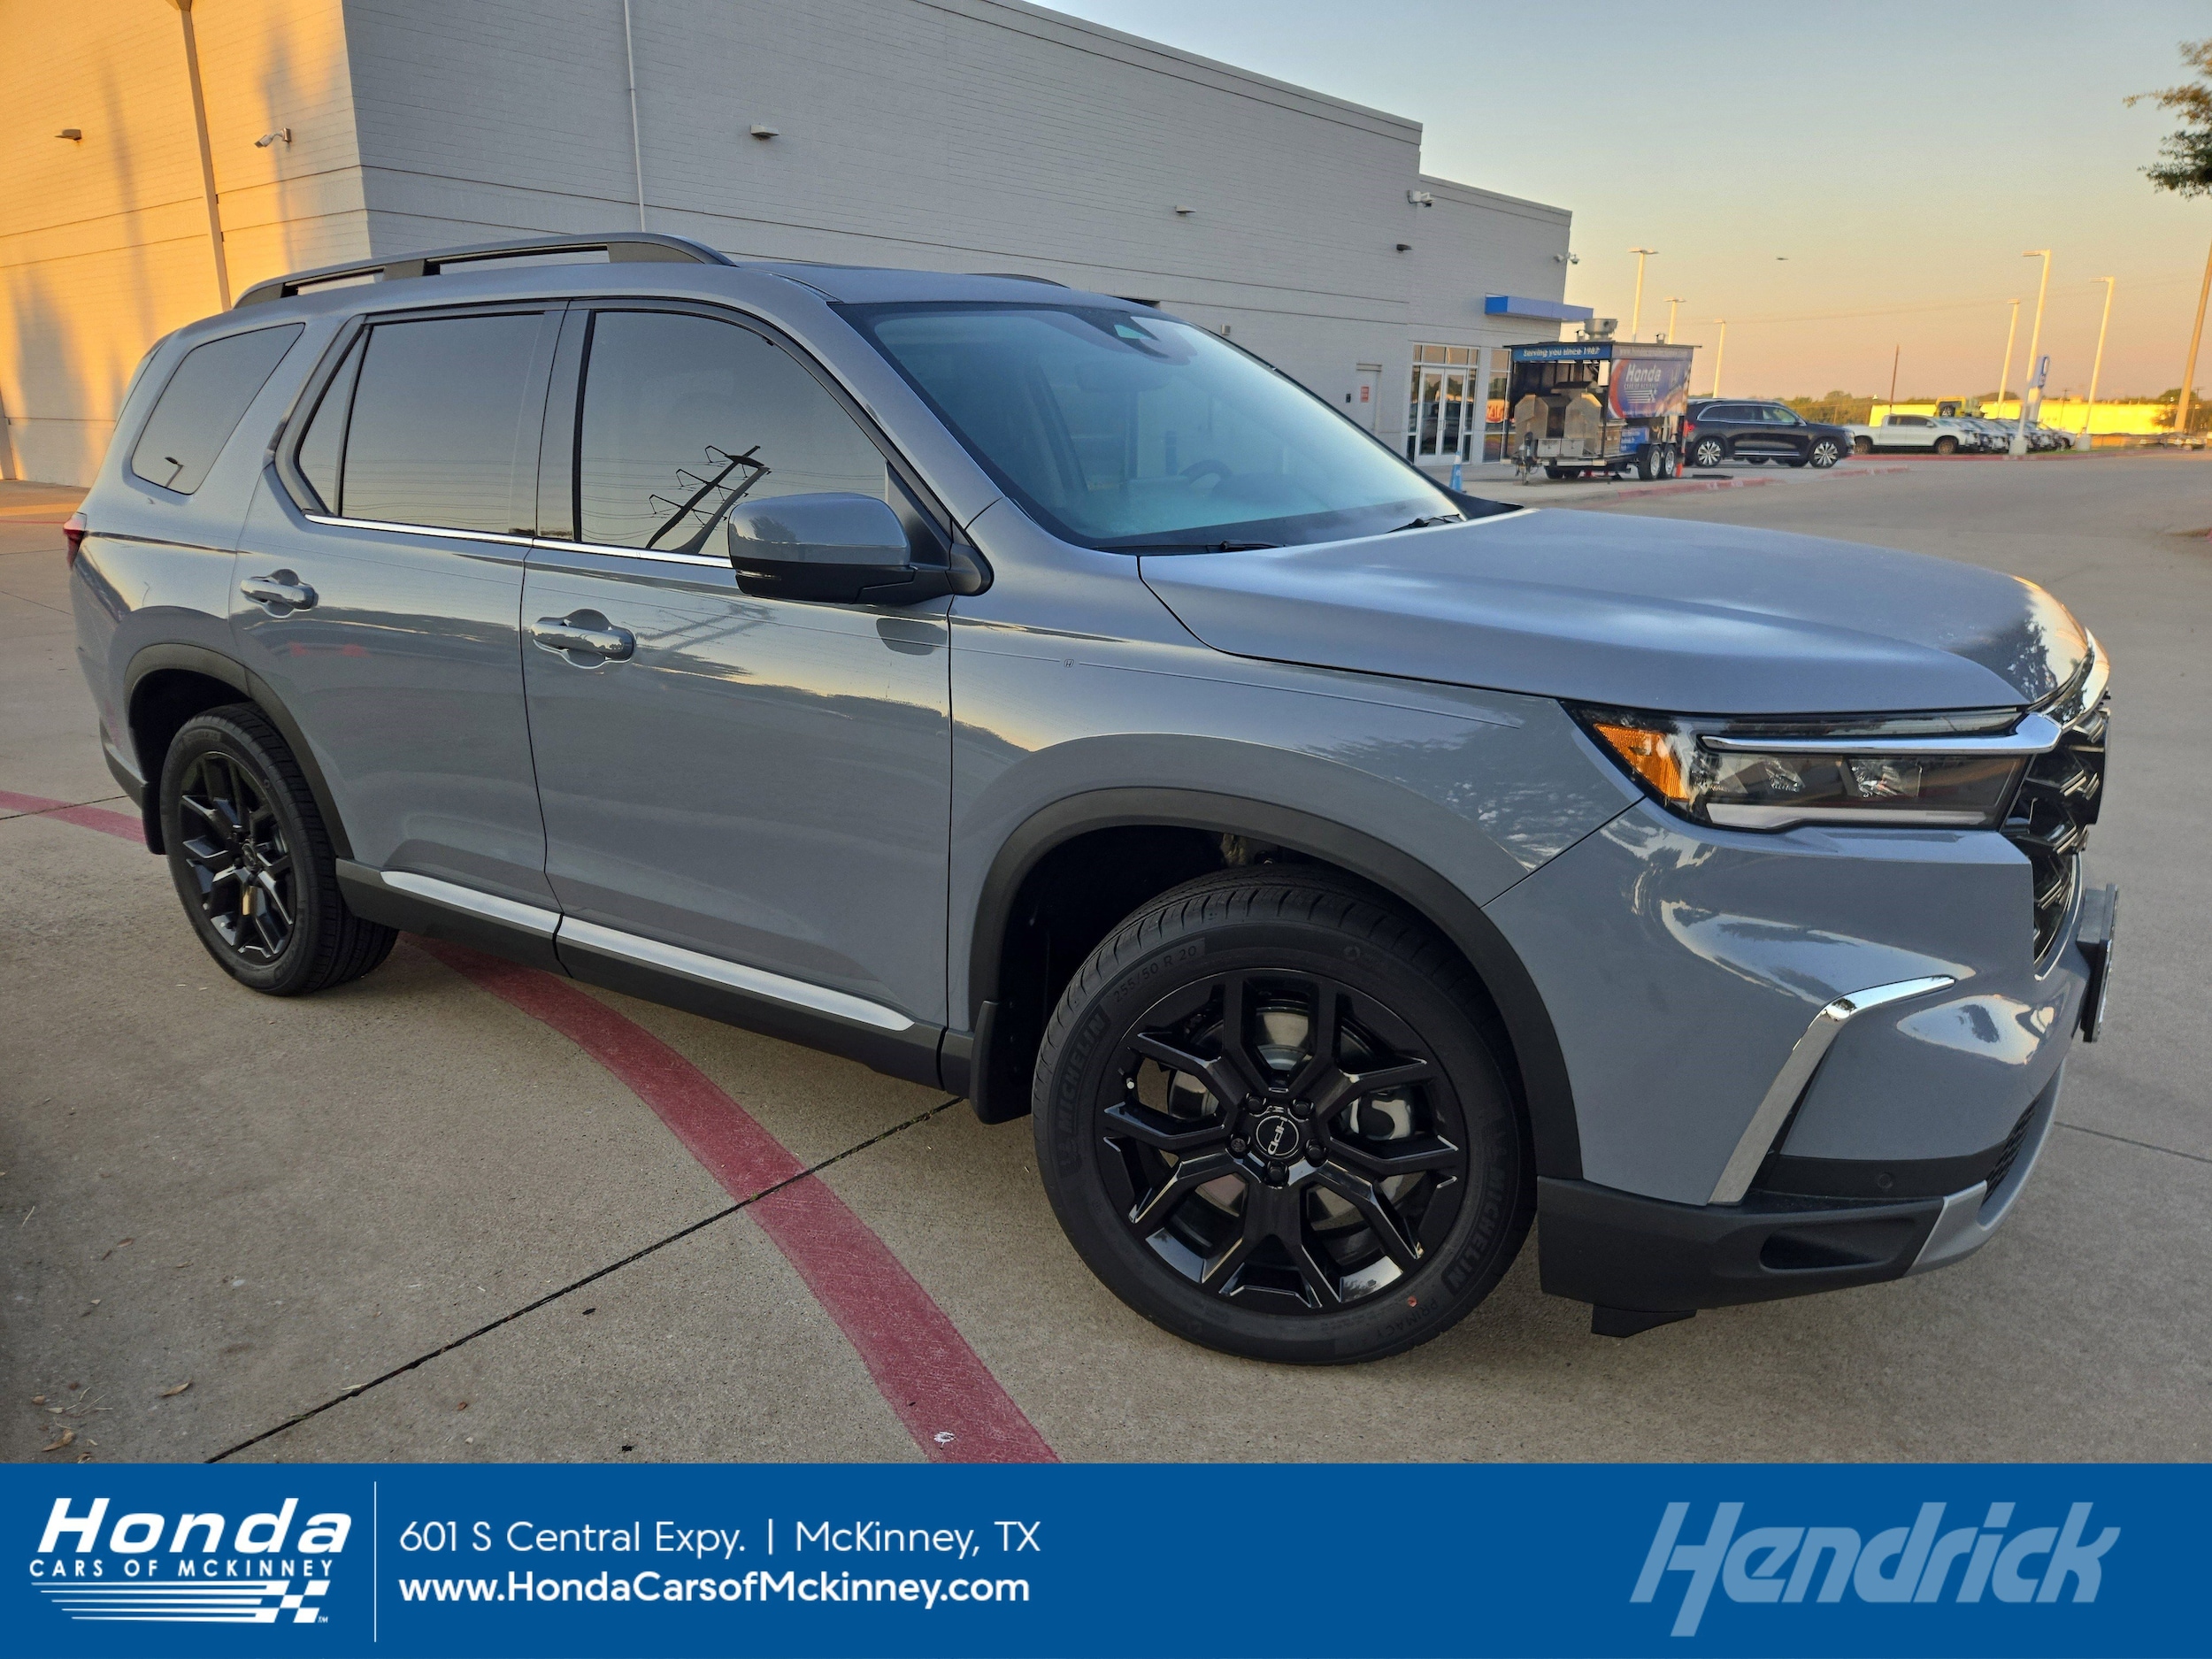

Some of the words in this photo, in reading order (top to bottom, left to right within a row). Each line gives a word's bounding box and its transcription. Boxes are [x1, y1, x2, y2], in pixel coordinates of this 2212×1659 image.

[1523, 347, 1548, 358] Serving
[1548, 348, 1562, 357] you
[1625, 363, 1662, 382] Honda
[1112, 961, 1160, 1003] 255/50
[1163, 953, 1175, 967] R
[1179, 944, 1197, 962] 20
[1058, 1011, 1107, 1134] MICHELIN
[1447, 1166, 1506, 1290] MICHELIN
[1375, 1298, 1439, 1339] PRIMACY
